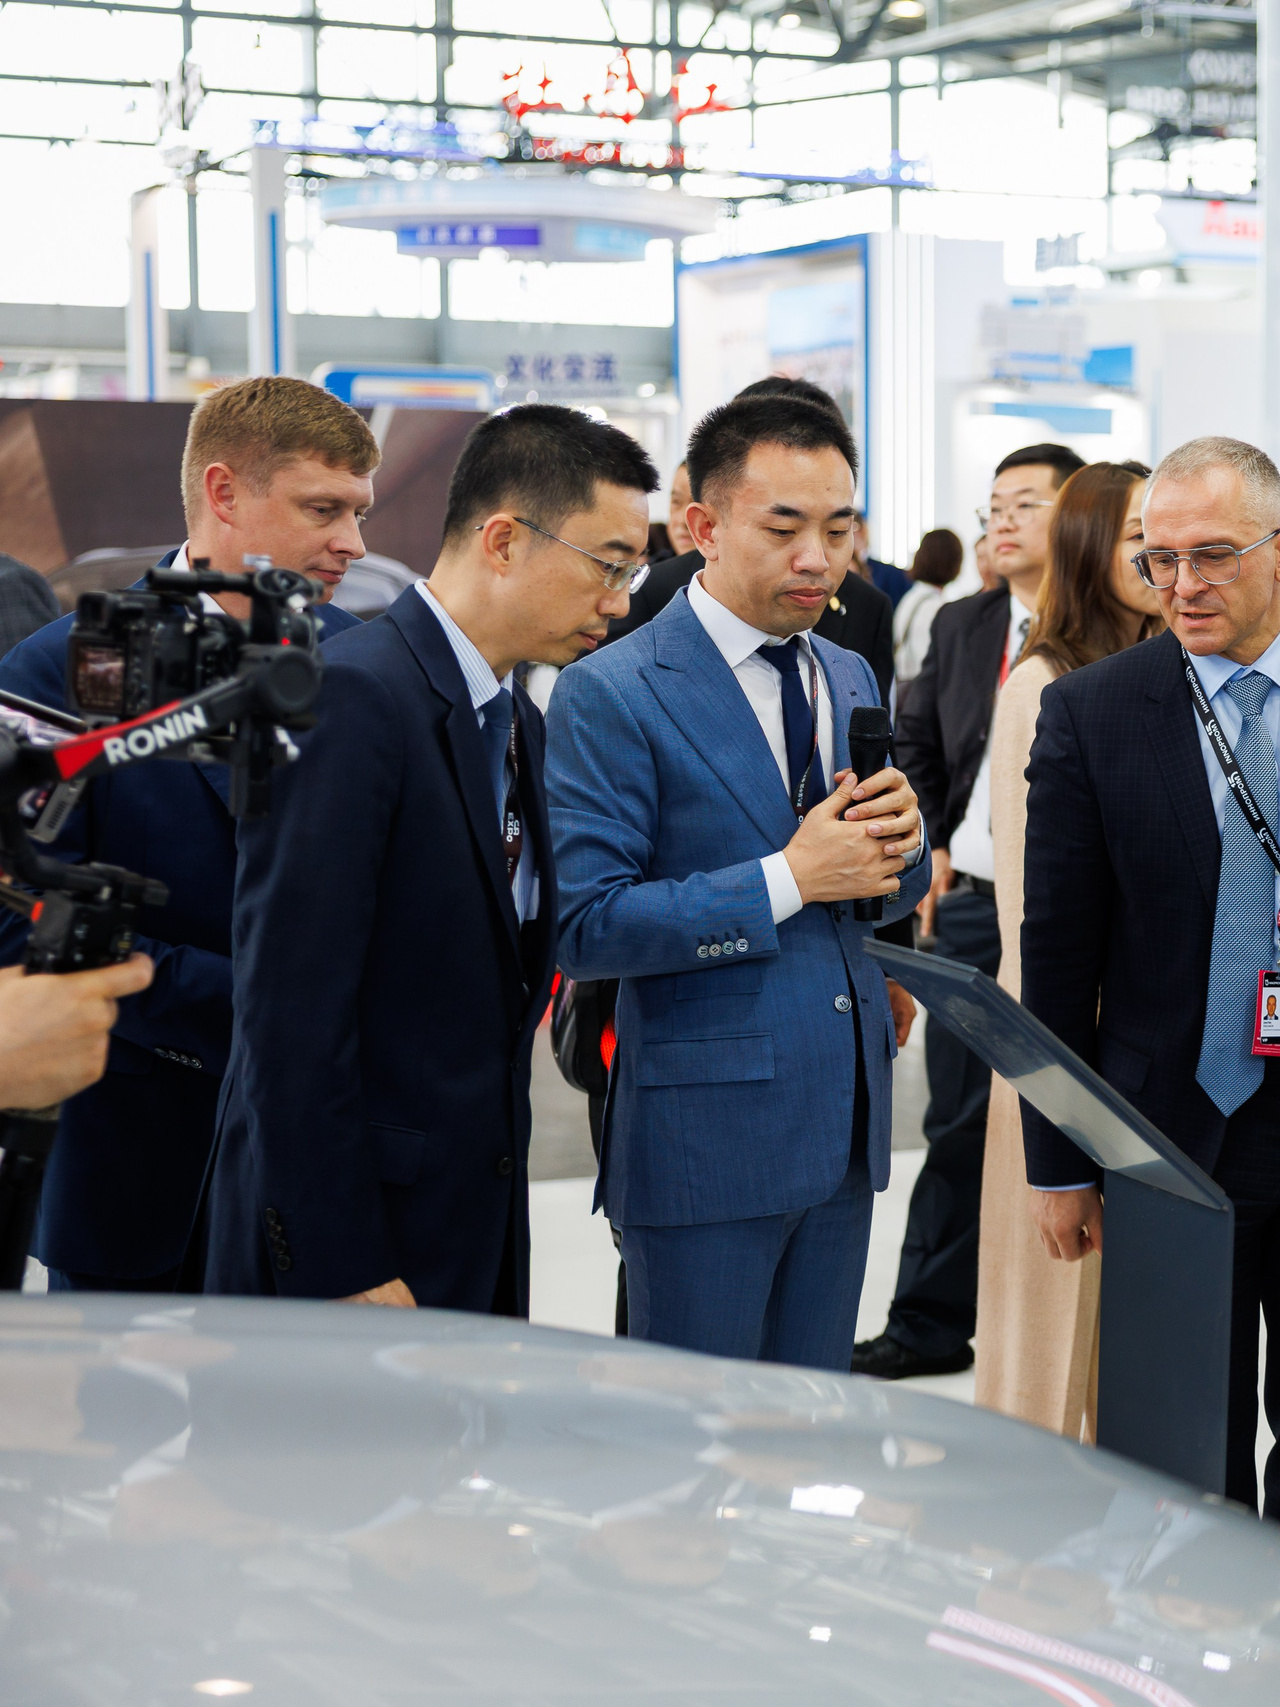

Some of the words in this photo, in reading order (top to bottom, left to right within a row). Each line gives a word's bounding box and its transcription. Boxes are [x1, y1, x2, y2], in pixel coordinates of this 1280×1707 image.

[1188, 671, 1209, 713] ИННОПРОМ
[103, 704, 208, 766] RONIN
[1211, 724, 1232, 764] INNOPROM
[1233, 777, 1260, 821] ИННОПРОМ
[506, 812, 515, 843] EXPO
